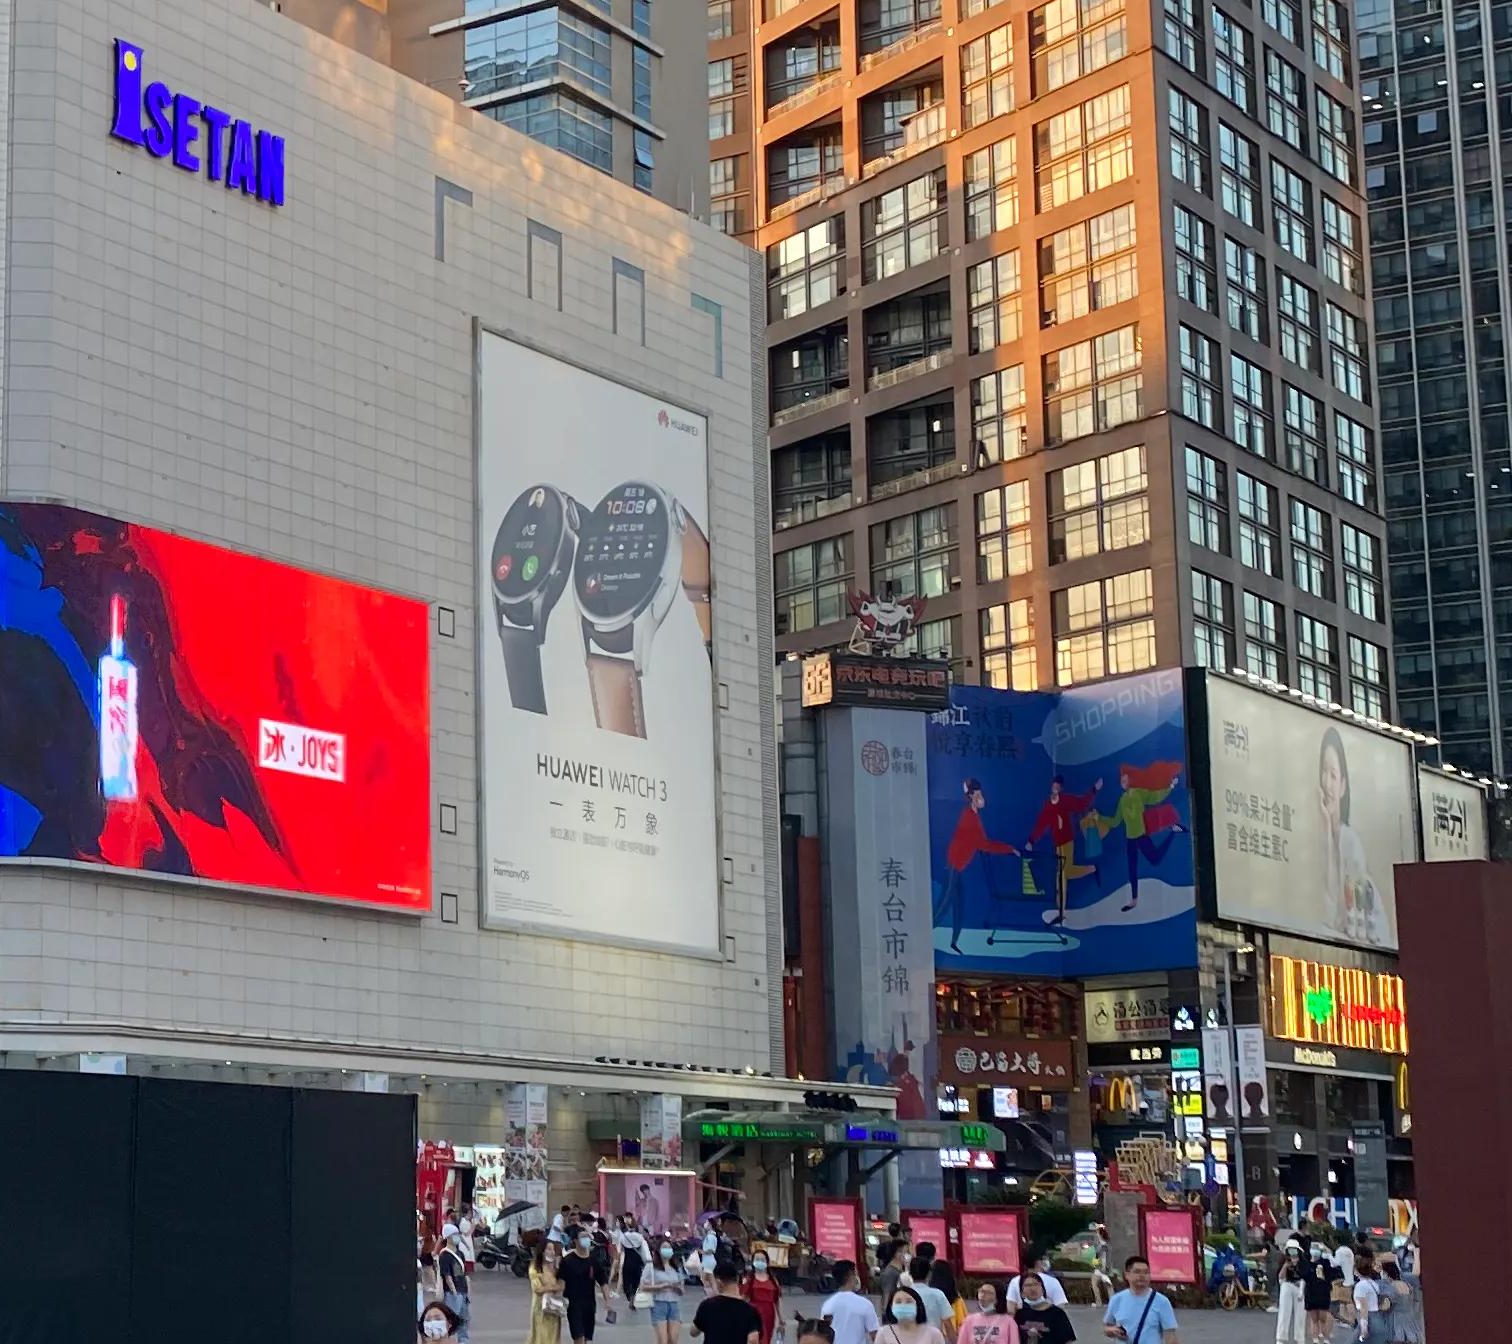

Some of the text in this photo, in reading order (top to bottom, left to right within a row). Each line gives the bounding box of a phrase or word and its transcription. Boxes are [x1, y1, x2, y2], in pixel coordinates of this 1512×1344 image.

[1054, 672, 1174, 745] SHOPPING
[536, 752, 668, 802] HUAWEI WATCH 3
[549, 799, 659, 836] 一表万象
[878, 856, 910, 997] 春台市锦
